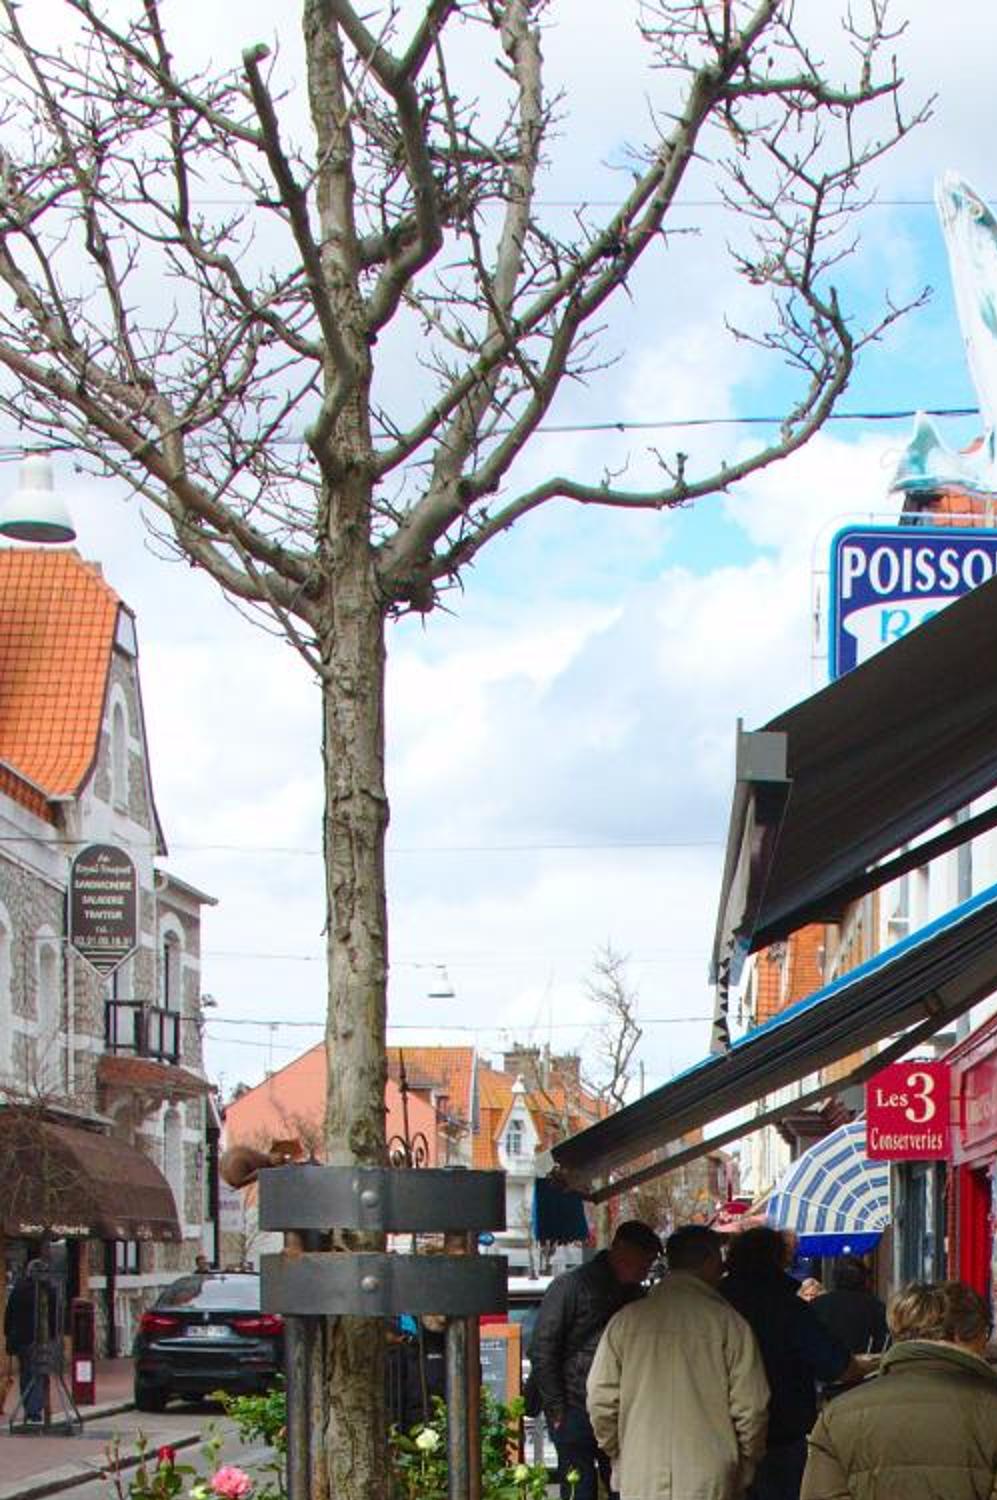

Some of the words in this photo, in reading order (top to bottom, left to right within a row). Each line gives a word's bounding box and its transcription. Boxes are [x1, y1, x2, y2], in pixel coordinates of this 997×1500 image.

[875, 1088, 908, 1107] Les
[905, 1072, 936, 1123] 3
[870, 1127, 943, 1151] Conserveries
